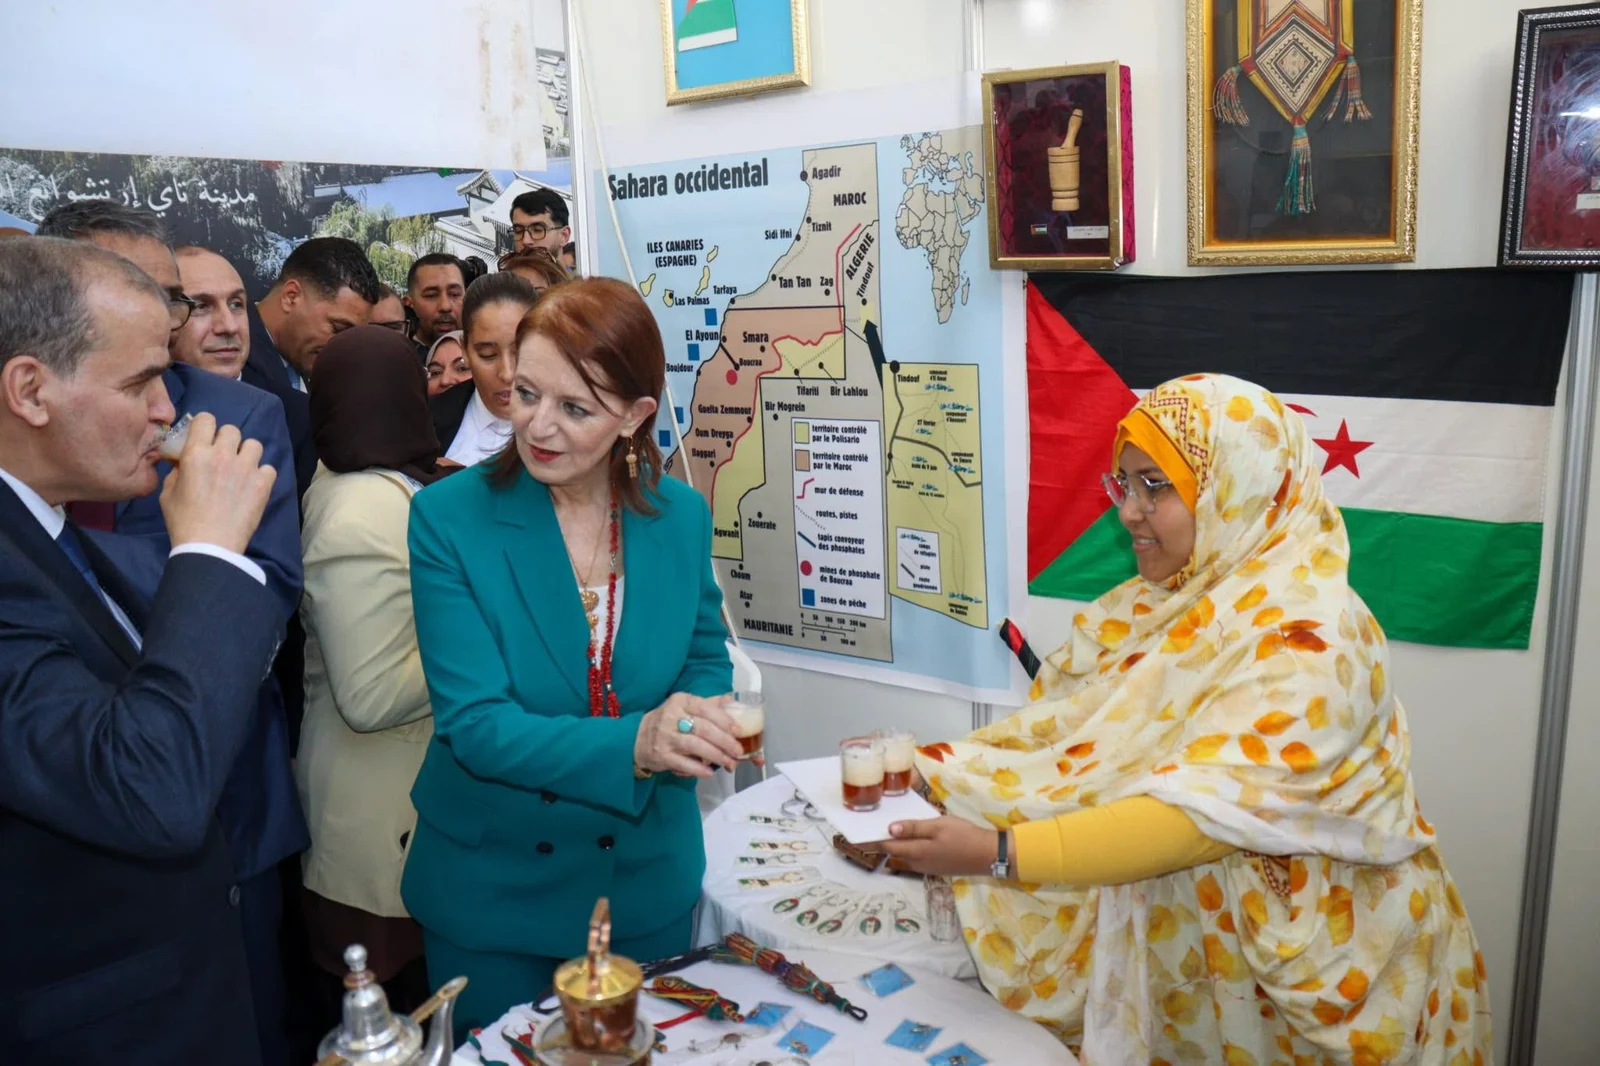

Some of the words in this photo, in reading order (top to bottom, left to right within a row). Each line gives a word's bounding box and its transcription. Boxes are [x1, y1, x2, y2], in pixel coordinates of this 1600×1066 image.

[812, 166, 841, 180] Agadir
[608, 172, 668, 200] Sahara
[674, 158, 768, 195] occidental
[148, 176, 188, 218] تاي
[199, 180, 257, 208] مدينة
[834, 192, 866, 206] MAROC
[812, 222, 832, 232] Tiznit
[765, 230, 778, 240] Sidi
[780, 228, 792, 239] Ifni
[647, 242, 663, 254] ILES
[666, 239, 704, 252] CANARIES
[656, 255, 697, 268] (ESPAGNE)
[845, 233, 874, 280] ALGERIE
[779, 277, 794, 288] Tan
[796, 276, 812, 288] Tan
[820, 276, 834, 287] Zag
[856, 262, 874, 298] Tindouf
[713, 286, 737, 295] Tarfaya
[675, 298, 685, 306] Las
[687, 296, 710, 305] Palmas
[686, 330, 693, 340] El
[696, 330, 718, 340] Ayoun
[743, 332, 769, 343] Smara
[666, 363, 693, 372] Boujdour
[898, 374, 920, 383] Tindouf
[797, 386, 819, 396] Tifariti
[830, 386, 840, 396] Bir
[843, 387, 868, 396] Lahlou
[721, 406, 751, 414] Zemmour
[765, 402, 775, 411] Bir
[777, 402, 805, 412] Mogrein
[696, 428, 709, 437] Oum
[812, 425, 839, 434] territoire
[841, 425, 867, 434] contrôlé
[832, 435, 860, 443] Polisario
[813, 452, 840, 461] territoire
[843, 453, 868, 462] contrôlé
[834, 462, 852, 471] Maroc
[839, 487, 864, 496] défense
[816, 510, 838, 518] routes,
[839, 511, 858, 520] pistes
[748, 518, 776, 530] Zouerate
[818, 533, 832, 542] tapis
[834, 536, 864, 544] convoyeur
[831, 544, 865, 554] phosphates
[731, 569, 751, 580] Choum
[820, 566, 837, 574] mines
[848, 569, 880, 580] phosphate
[829, 576, 852, 586] Boucraa
[740, 590, 752, 600] Atar
[821, 596, 837, 605] zones
[849, 600, 866, 608] pêche
[744, 619, 793, 636] MAURITANIE
